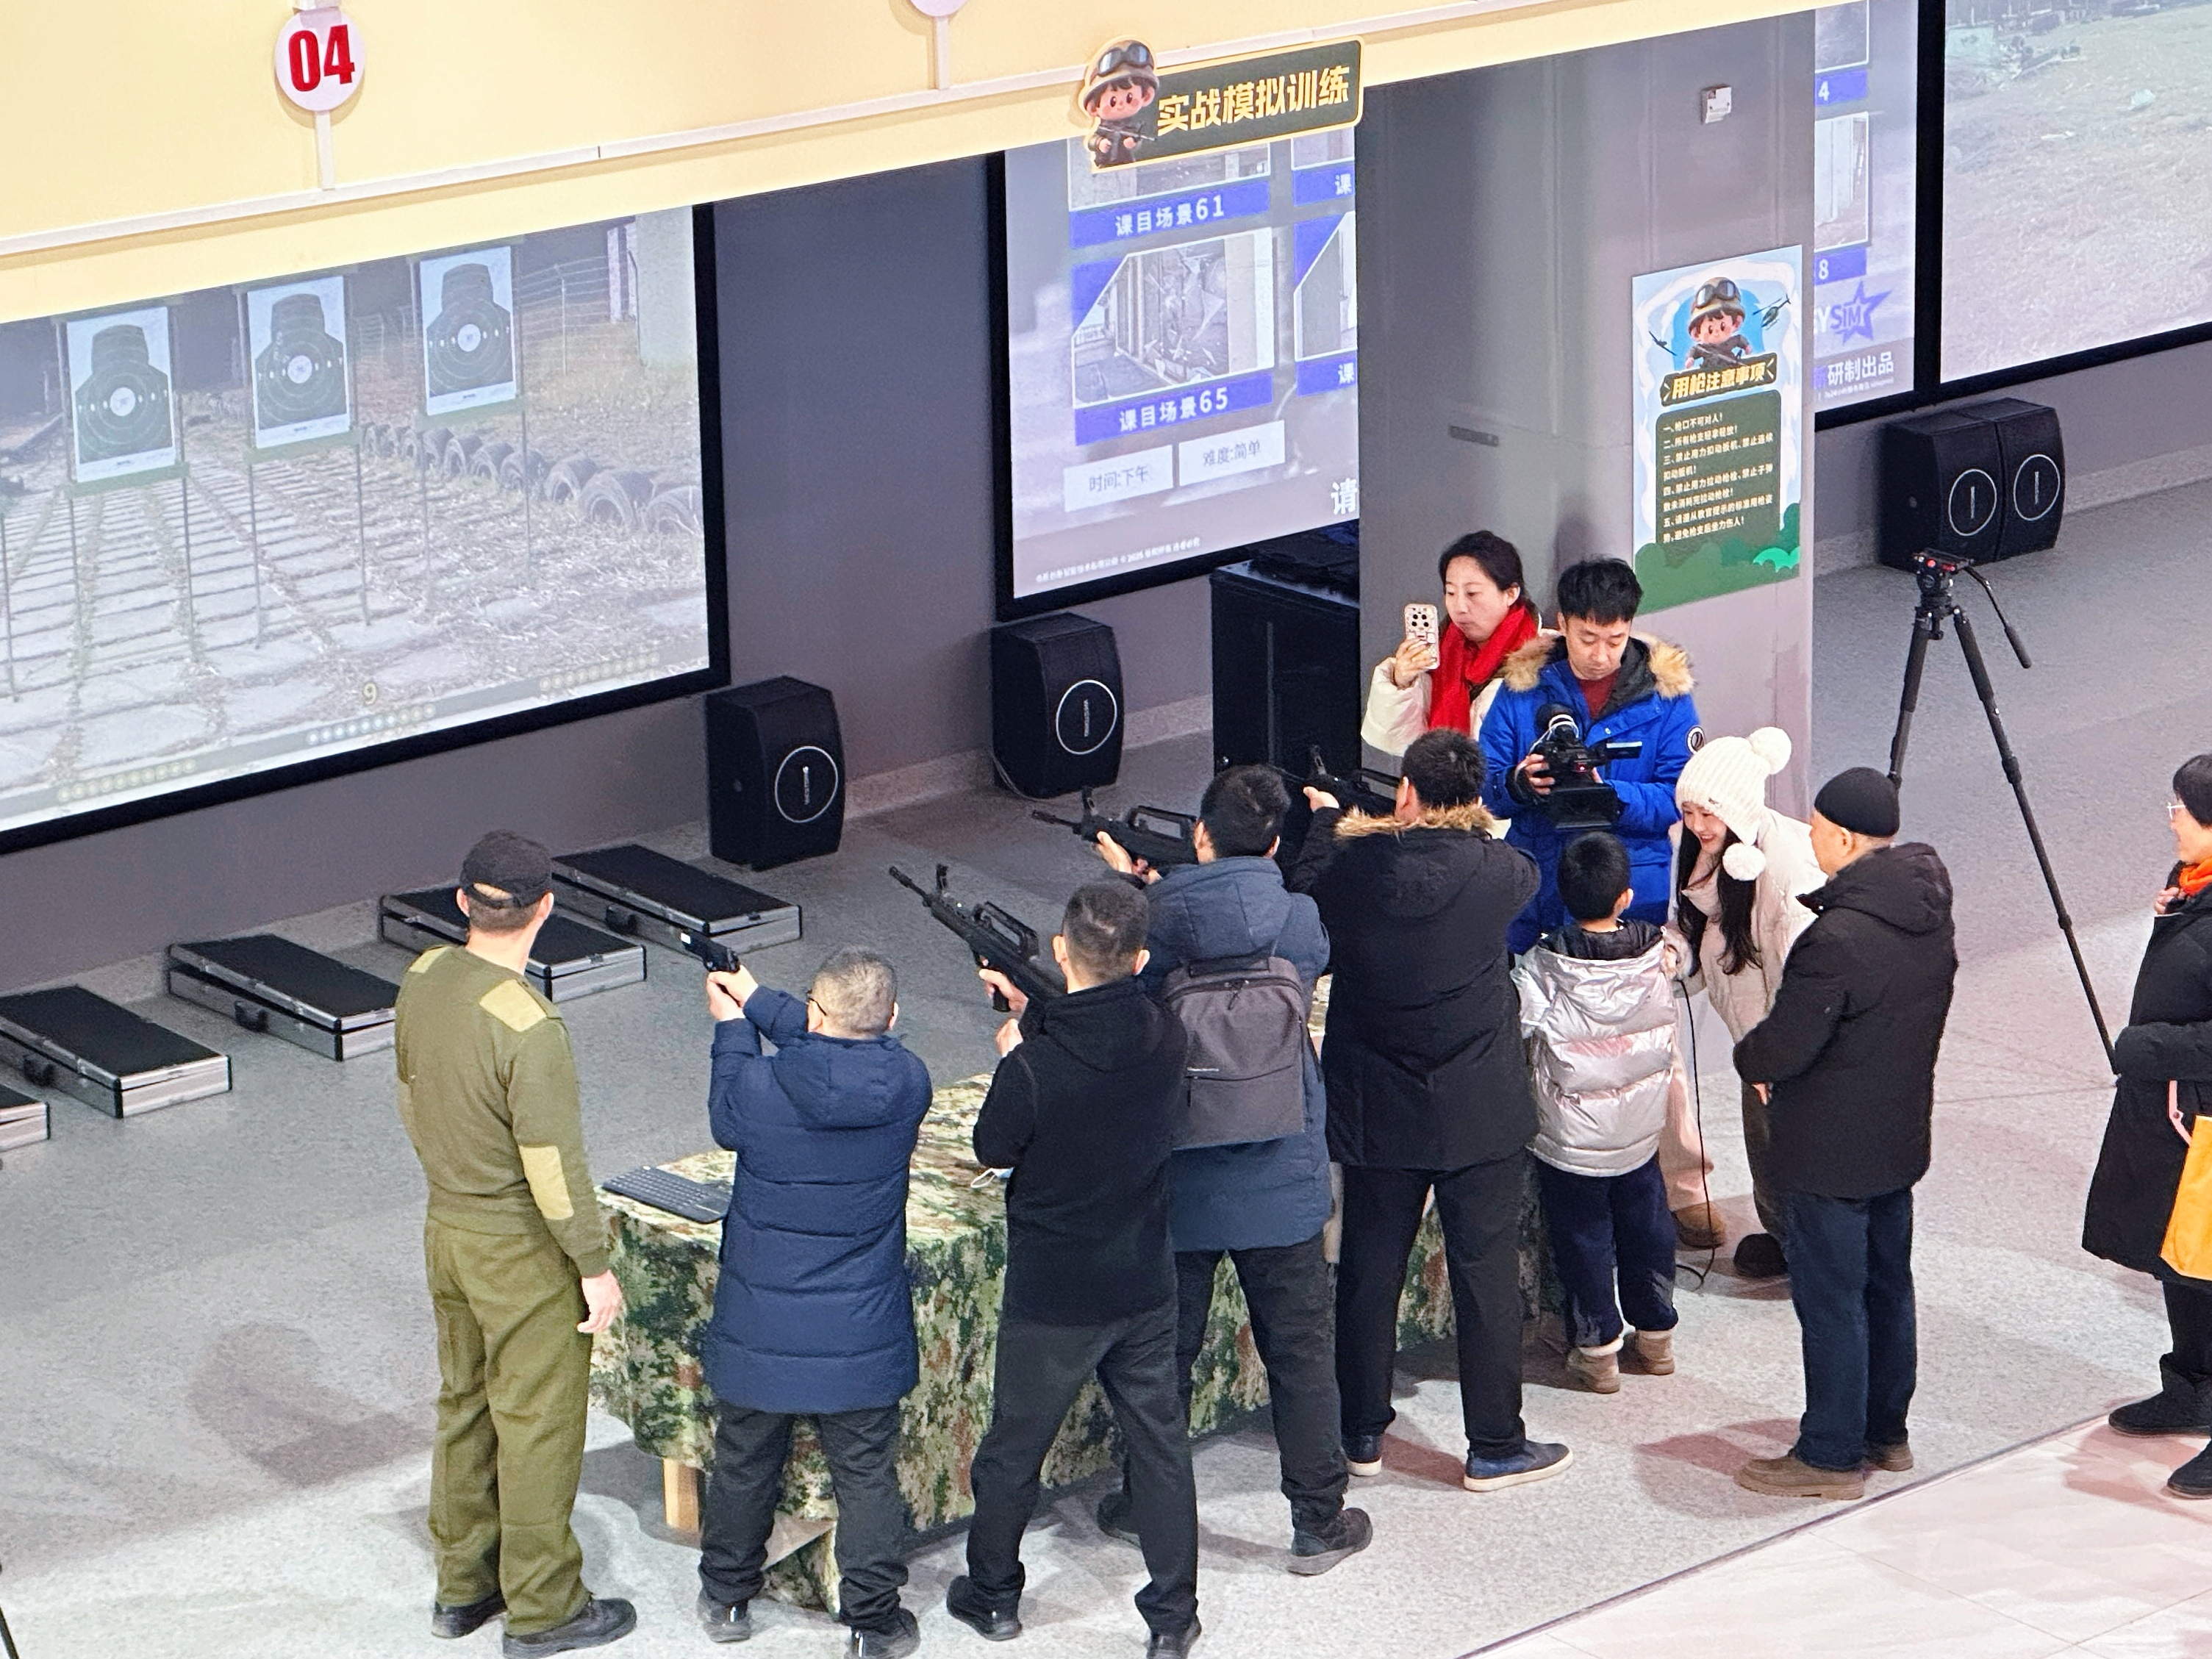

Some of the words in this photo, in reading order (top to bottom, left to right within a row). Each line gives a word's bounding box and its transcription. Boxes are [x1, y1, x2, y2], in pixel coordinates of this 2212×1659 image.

[289, 24, 355, 92] 04
[1157, 65, 1350, 137] 实战模拟训练
[1818, 80, 1830, 101] 4
[1334, 173, 1352, 196] 课
[1115, 195, 1225, 237] 课目场景61
[1818, 259, 1829, 280] 8
[1814, 304, 1861, 333] YSIM
[1338, 362, 1355, 384] 课
[1672, 362, 1766, 399] 用枪注意事项
[1119, 387, 1229, 432] 课目场景65
[1089, 465, 1149, 492] 时间:下午
[1331, 478, 1358, 515] 请
[362, 682, 376, 705] 9
